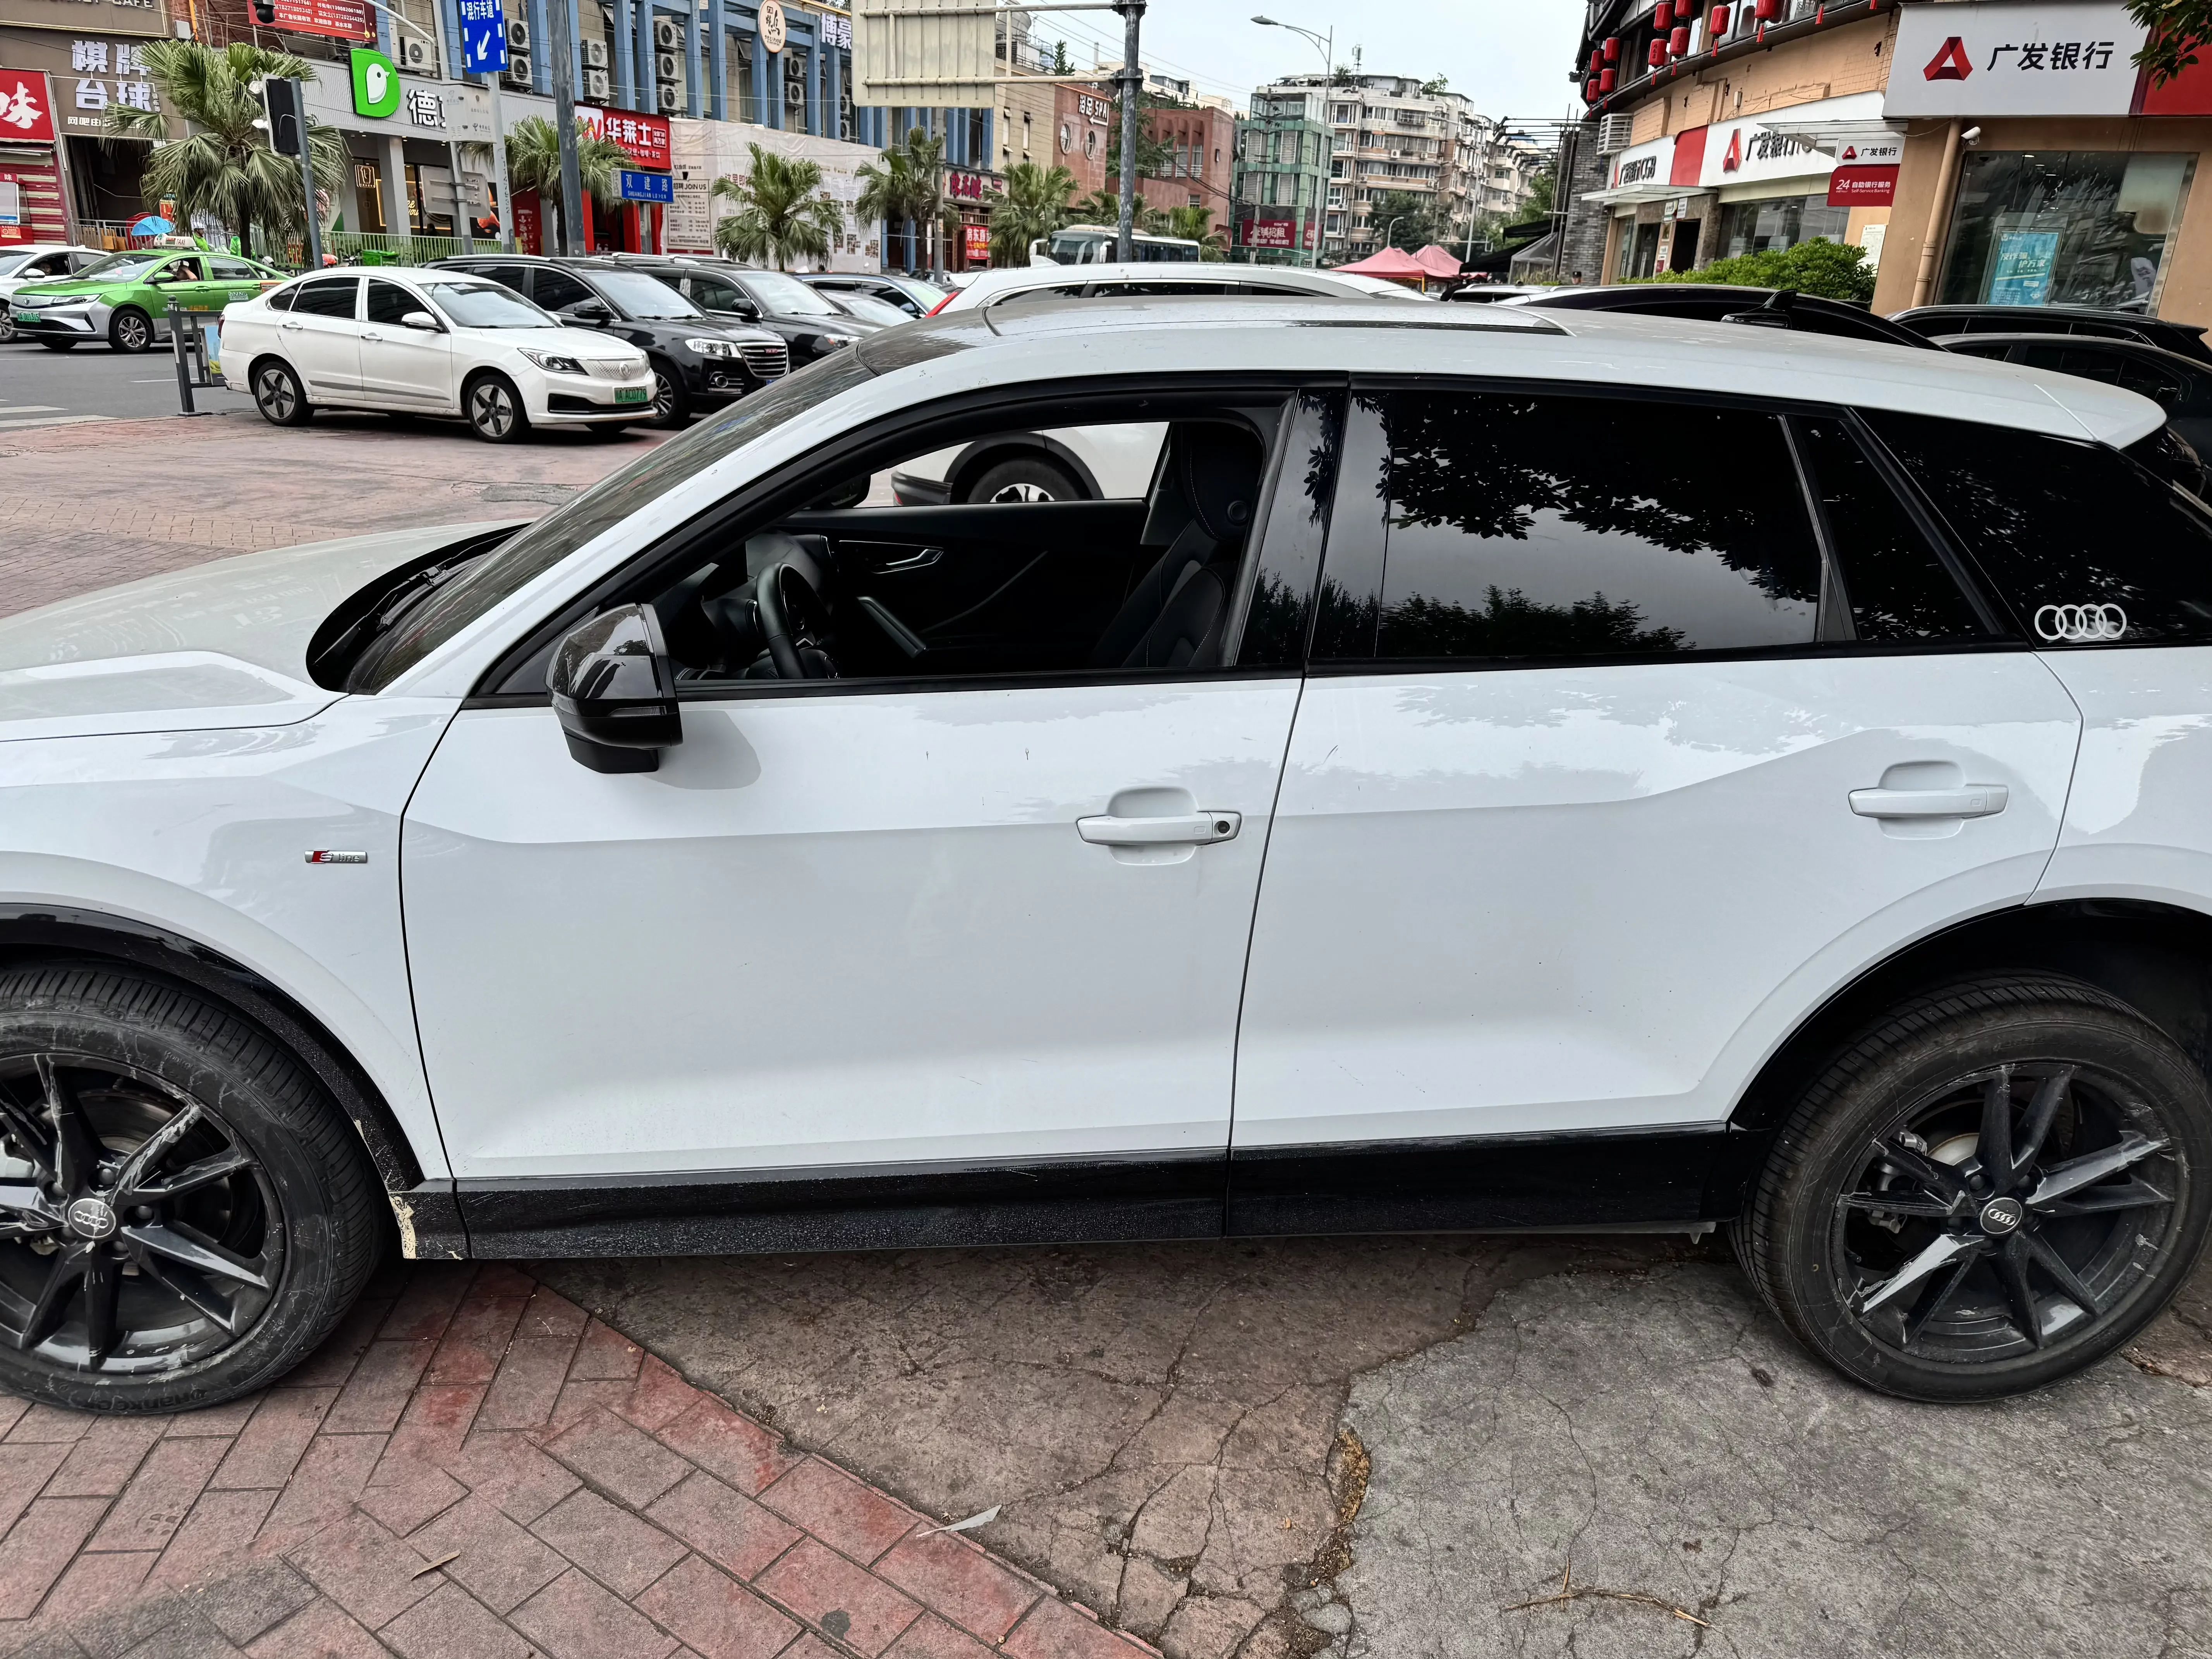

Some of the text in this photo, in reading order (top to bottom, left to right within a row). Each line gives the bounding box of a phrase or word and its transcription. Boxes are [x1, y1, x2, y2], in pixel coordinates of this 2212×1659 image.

[466, 0, 494, 21] 混行车道
[821, 13, 851, 50] 博豪
[72, 40, 153, 76] 棋牌
[1987, 41, 2114, 72] 广发银行
[76, 79, 153, 112] 台球
[408, 88, 447, 127] 德
[1094, 101, 1107, 118] SPA
[606, 117, 652, 146] 华莱士
[1861, 147, 1897, 156] 广发银行
[626, 174, 668, 192] 双建路
[1836, 179, 1850, 190] 24
[1250, 227, 1286, 238] 铺招租
[319, 853, 360, 862] S line
